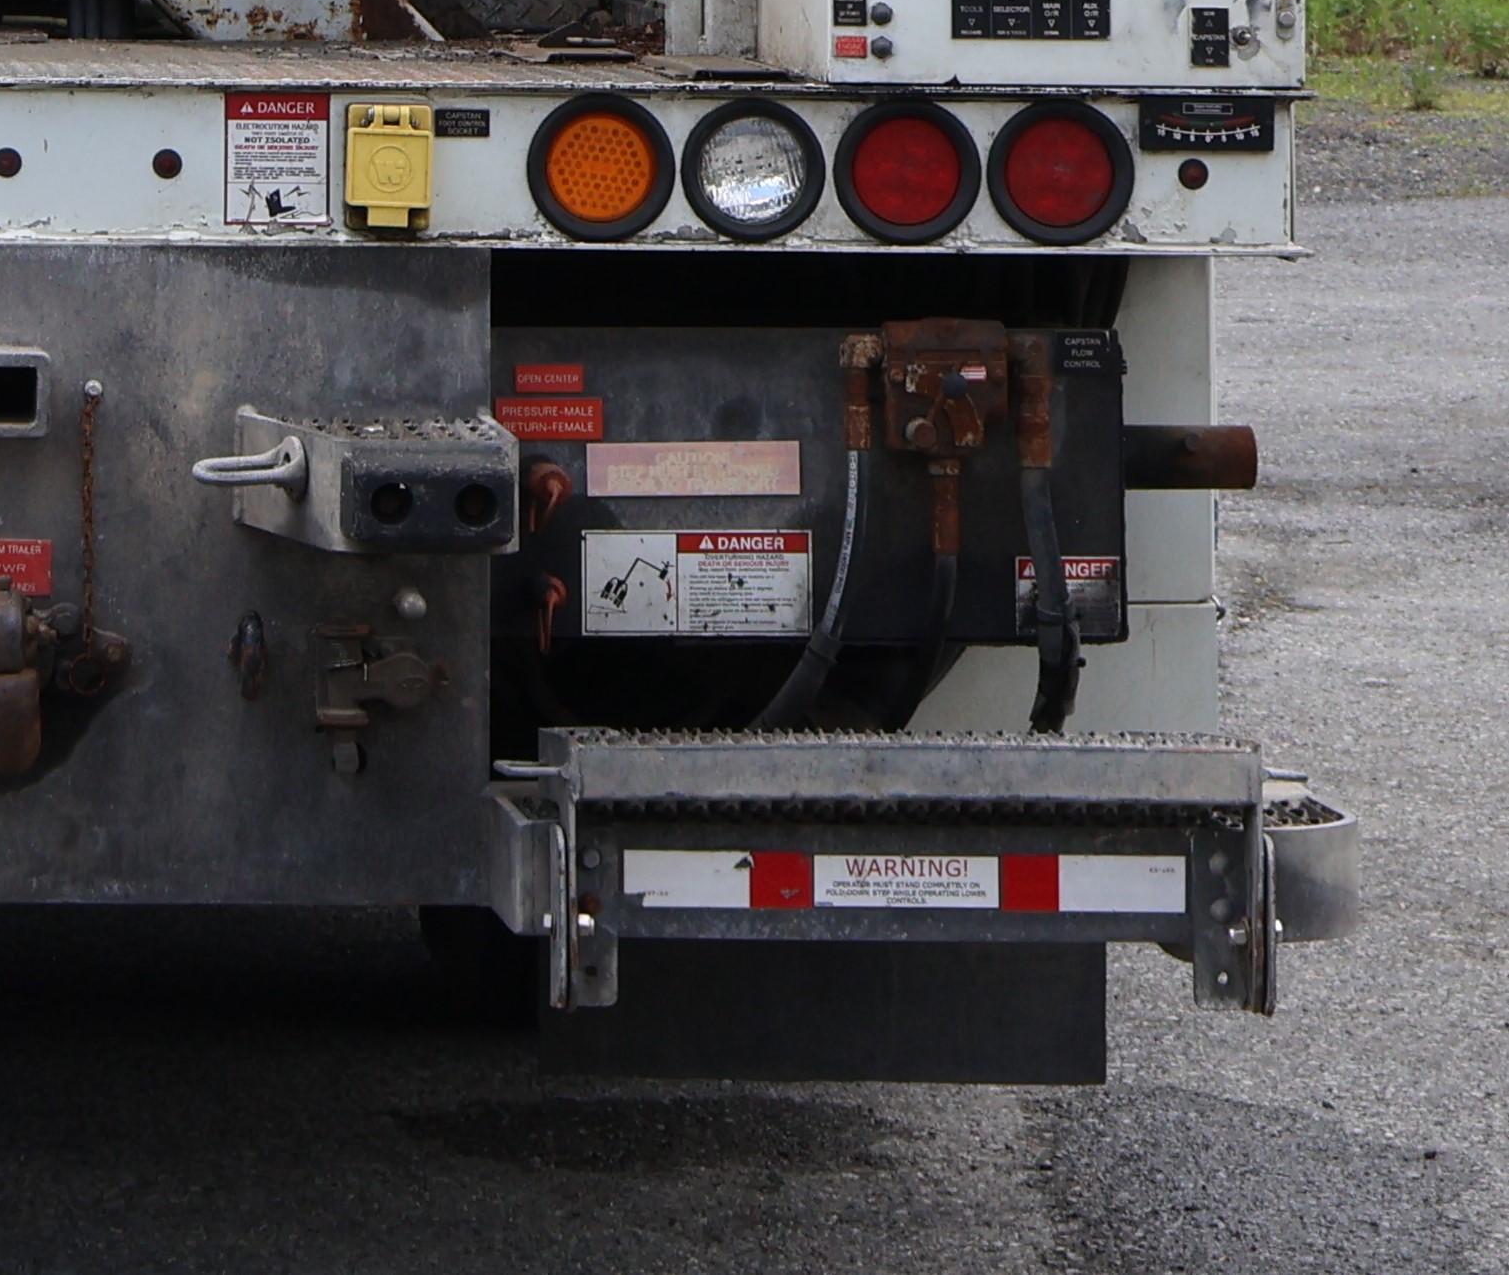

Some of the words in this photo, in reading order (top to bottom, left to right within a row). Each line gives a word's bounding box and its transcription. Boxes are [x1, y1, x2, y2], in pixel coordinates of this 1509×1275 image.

[258, 102, 315, 114] DANGER
[236, 122, 290, 130] ELECTROCUTION
[292, 122, 319, 130] HAZARD
[1065, 338, 1101, 346] CAPSTAN
[1071, 348, 1094, 357] FLOW
[1063, 360, 1101, 368] CONTROL
[517, 374, 541, 383] OPEN
[544, 374, 579, 383] CENTER
[502, 406, 594, 417] PRESSURE-MALE
[504, 421, 594, 432] RETURN-FEMALE
[718, 537, 784, 550] DANGER
[7, 545, 41, 554] TRAILER
[1064, 562, 1113, 577] NGER
[845, 858, 968, 877] WARNING!
[832, 880, 870, 889] OPERATOR
[873, 880, 893, 889] MUST
[895, 880, 920, 889] STAND
[922, 880, 966, 889] COMPLETELY
[968, 880, 980, 889] ON
[826, 889, 870, 897] FOLD-DOWN
[872, 889, 891, 897] STEP
[893, 889, 916, 897] WHILE
[918, 889, 959, 897] OPERATING
[961, 889, 986, 897] LOWER
